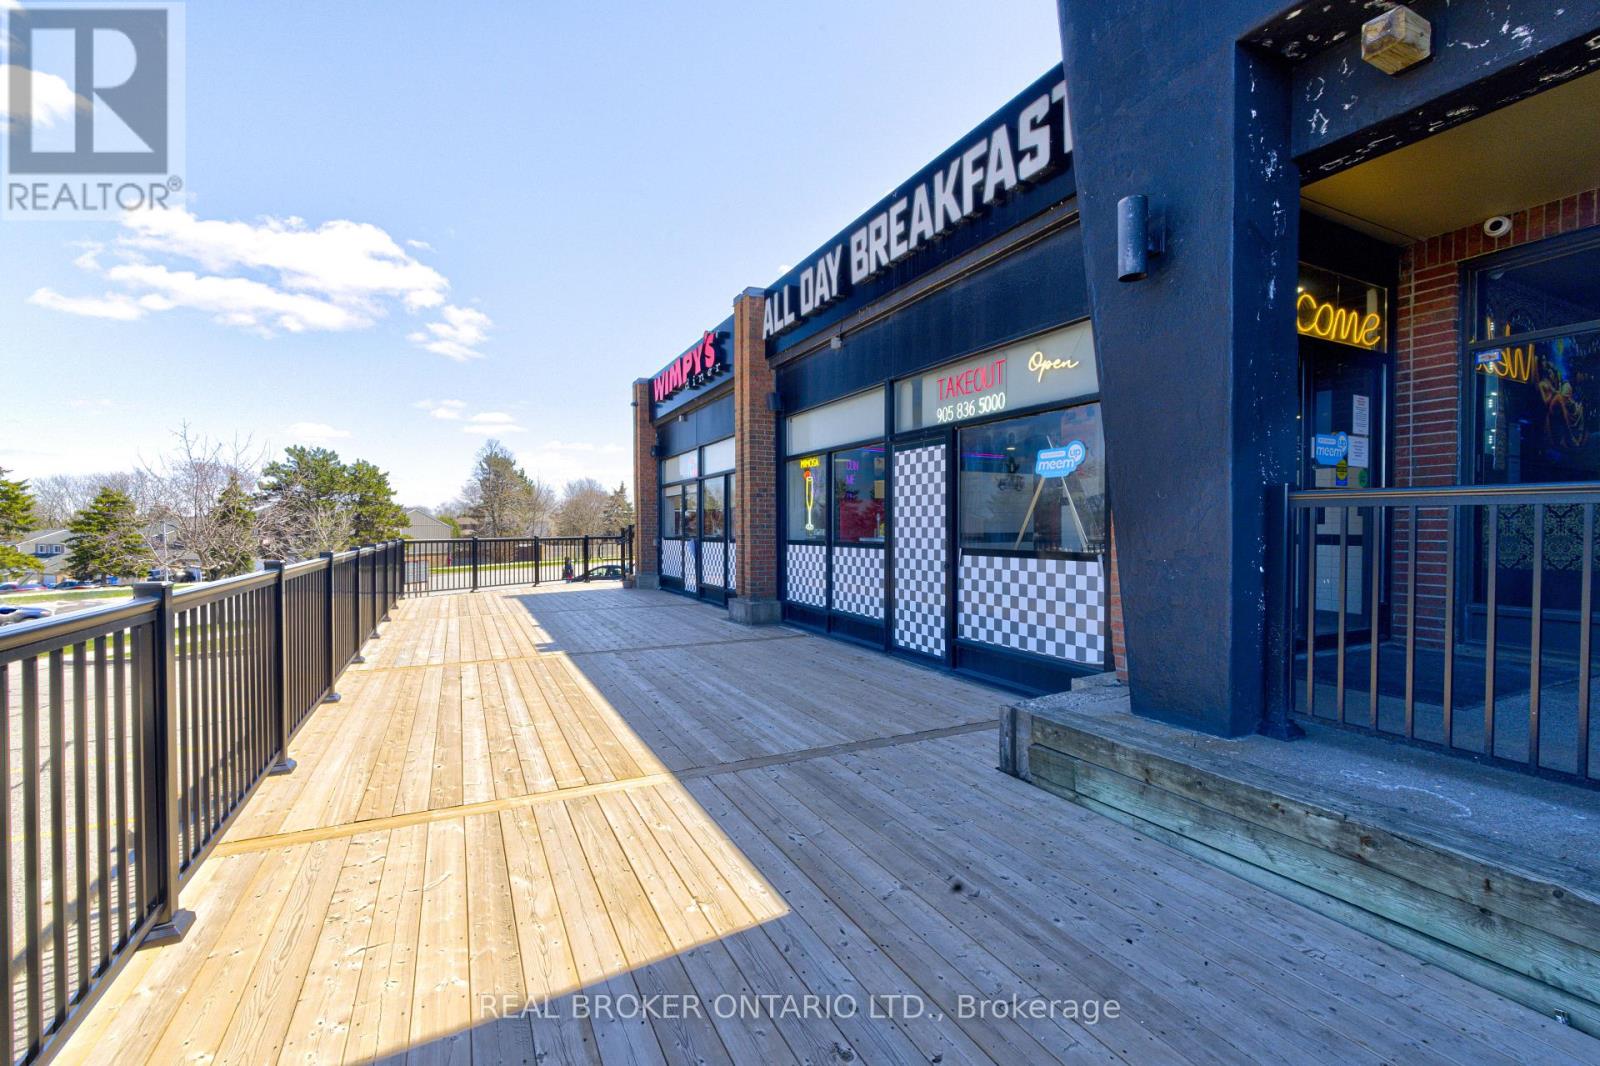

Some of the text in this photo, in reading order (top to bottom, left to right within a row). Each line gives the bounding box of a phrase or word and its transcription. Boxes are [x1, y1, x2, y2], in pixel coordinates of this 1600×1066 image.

[762, 80, 1073, 341] ALL DAY BREAKFAST
[653, 330, 715, 402] WIMPY'S
[936, 359, 1007, 401] TAKEOUT
[1028, 351, 1079, 383] Open
[936, 392, 1006, 425] 905 836 5000
